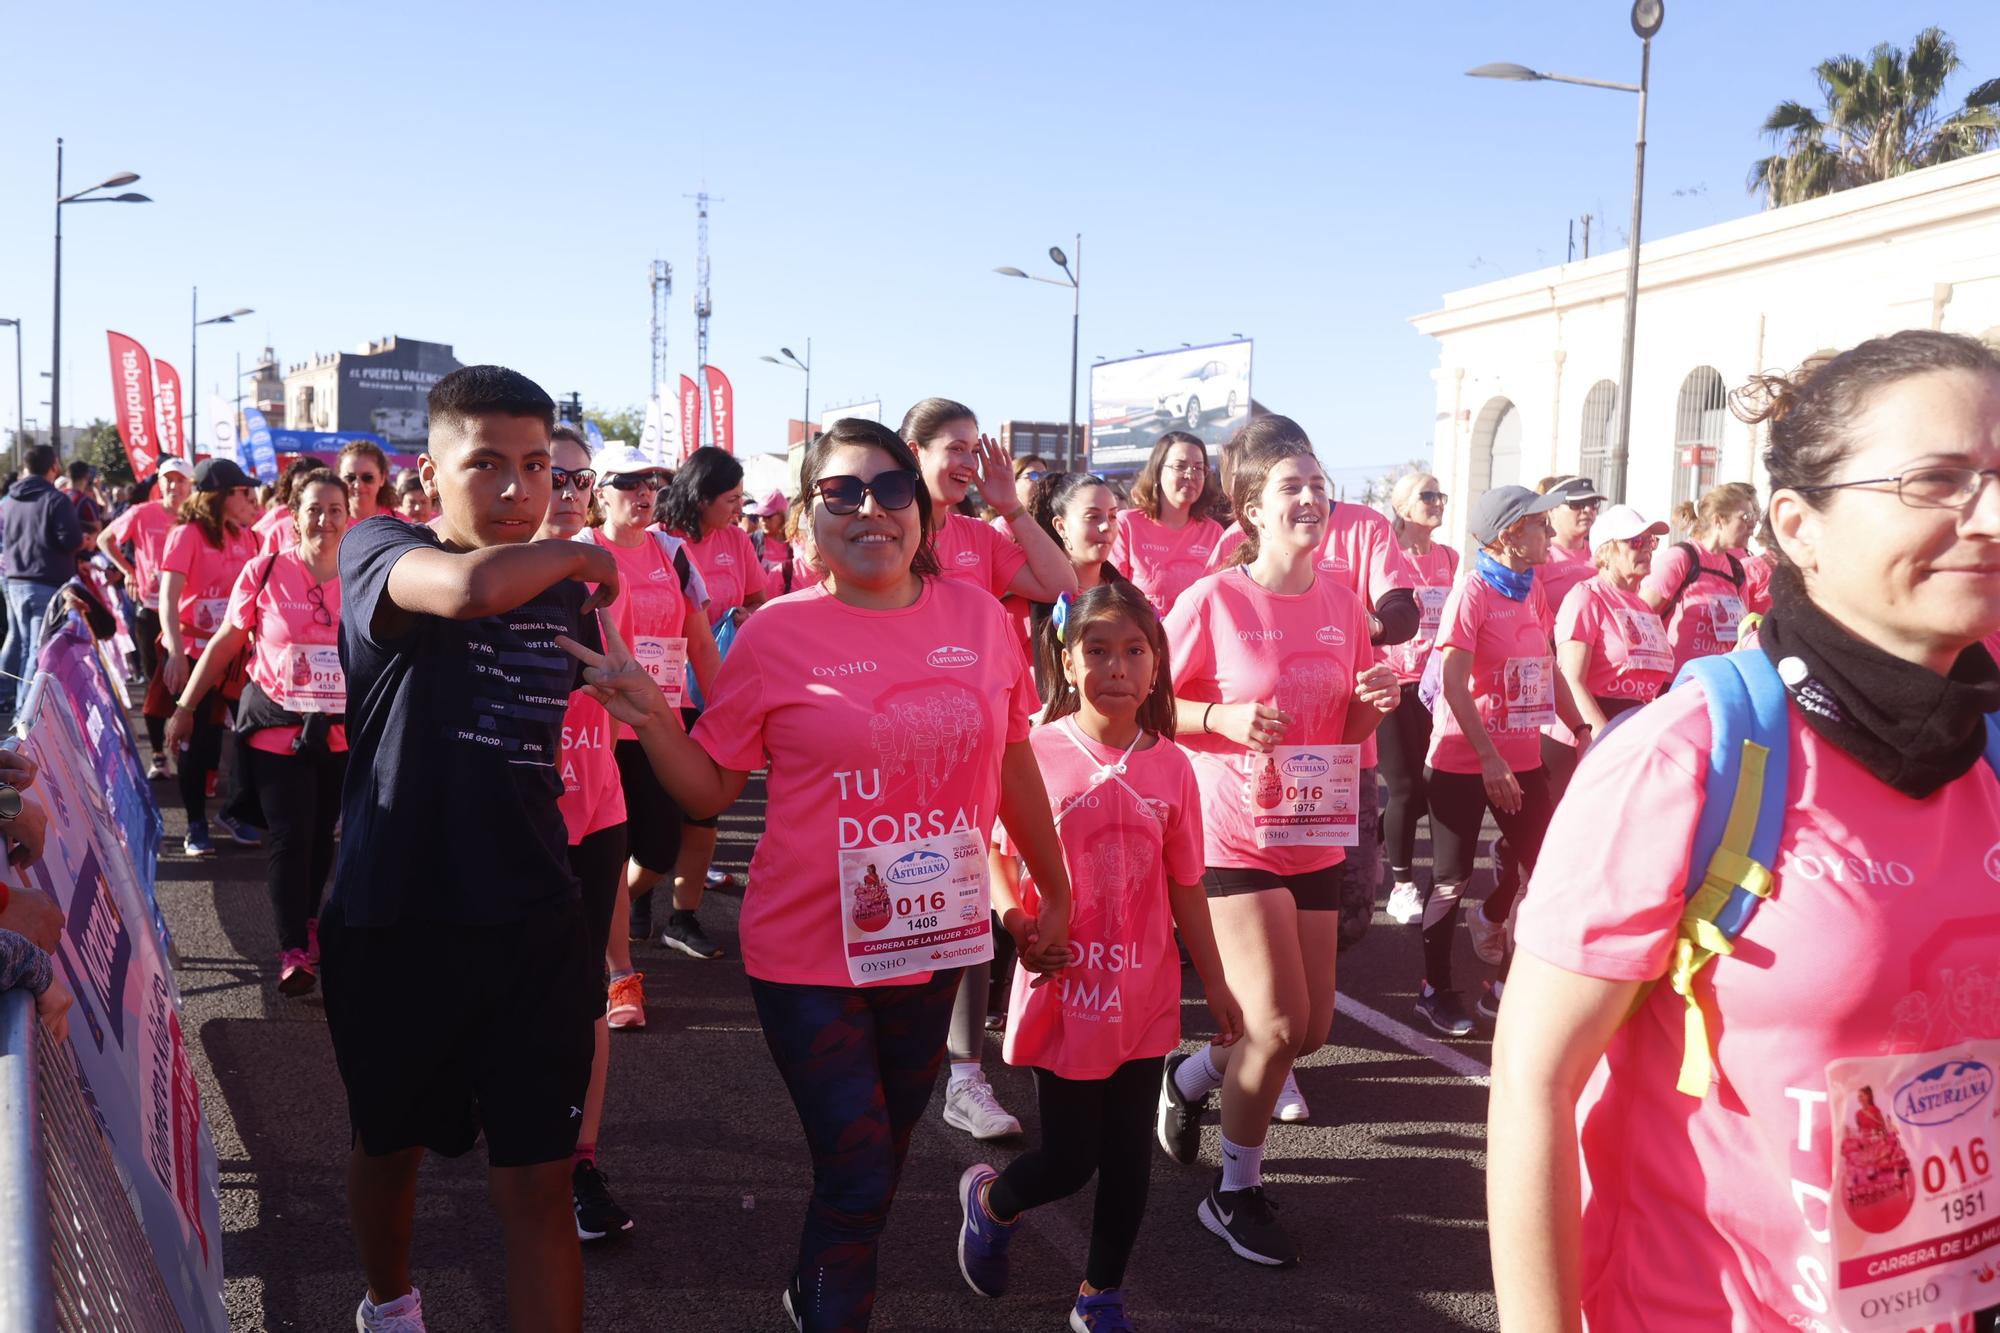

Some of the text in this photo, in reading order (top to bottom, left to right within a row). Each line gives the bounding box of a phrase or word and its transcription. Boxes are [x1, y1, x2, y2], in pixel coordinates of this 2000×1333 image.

[362, 367, 400, 380] PUERTO
[402, 369, 444, 383] VALENC
[509, 622, 545, 631] ORIGINAL
[1239, 630, 1283, 641] OYSHO
[931, 653, 975, 666] ASTURIANA
[314, 672, 341, 682] 016
[812, 660, 878, 678] OYSHO
[457, 731, 500, 746] THE GOOD
[1286, 763, 1326, 773] ASTURIANA
[833, 768, 881, 801] TU
[1286, 786, 1323, 801] 016
[1293, 803, 1316, 813] 1975
[1315, 830, 1350, 838] Santander
[953, 848, 979, 859] SUMA
[892, 862, 946, 880] ASTURIANA
[1794, 855, 1915, 887] OYSHO
[896, 891, 946, 916] 016
[907, 915, 938, 931] 1408
[864, 940, 905, 952] CARRERA
[907, 936, 919, 946] DE
[921, 934, 931, 944] LA
[934, 931, 961, 941] MUJER
[861, 944, 985, 973] OYSHO Santander
[1904, 1080, 1986, 1117] ASTURIANA
[1922, 1136, 1990, 1194] 016
[1941, 1190, 1986, 1224] 1951
[1867, 1246, 1936, 1276] CARRERA
[1940, 1240, 1961, 1256] DE
[1964, 1235, 1980, 1250] LA
[1860, 1282, 1940, 1319] OYSHO
